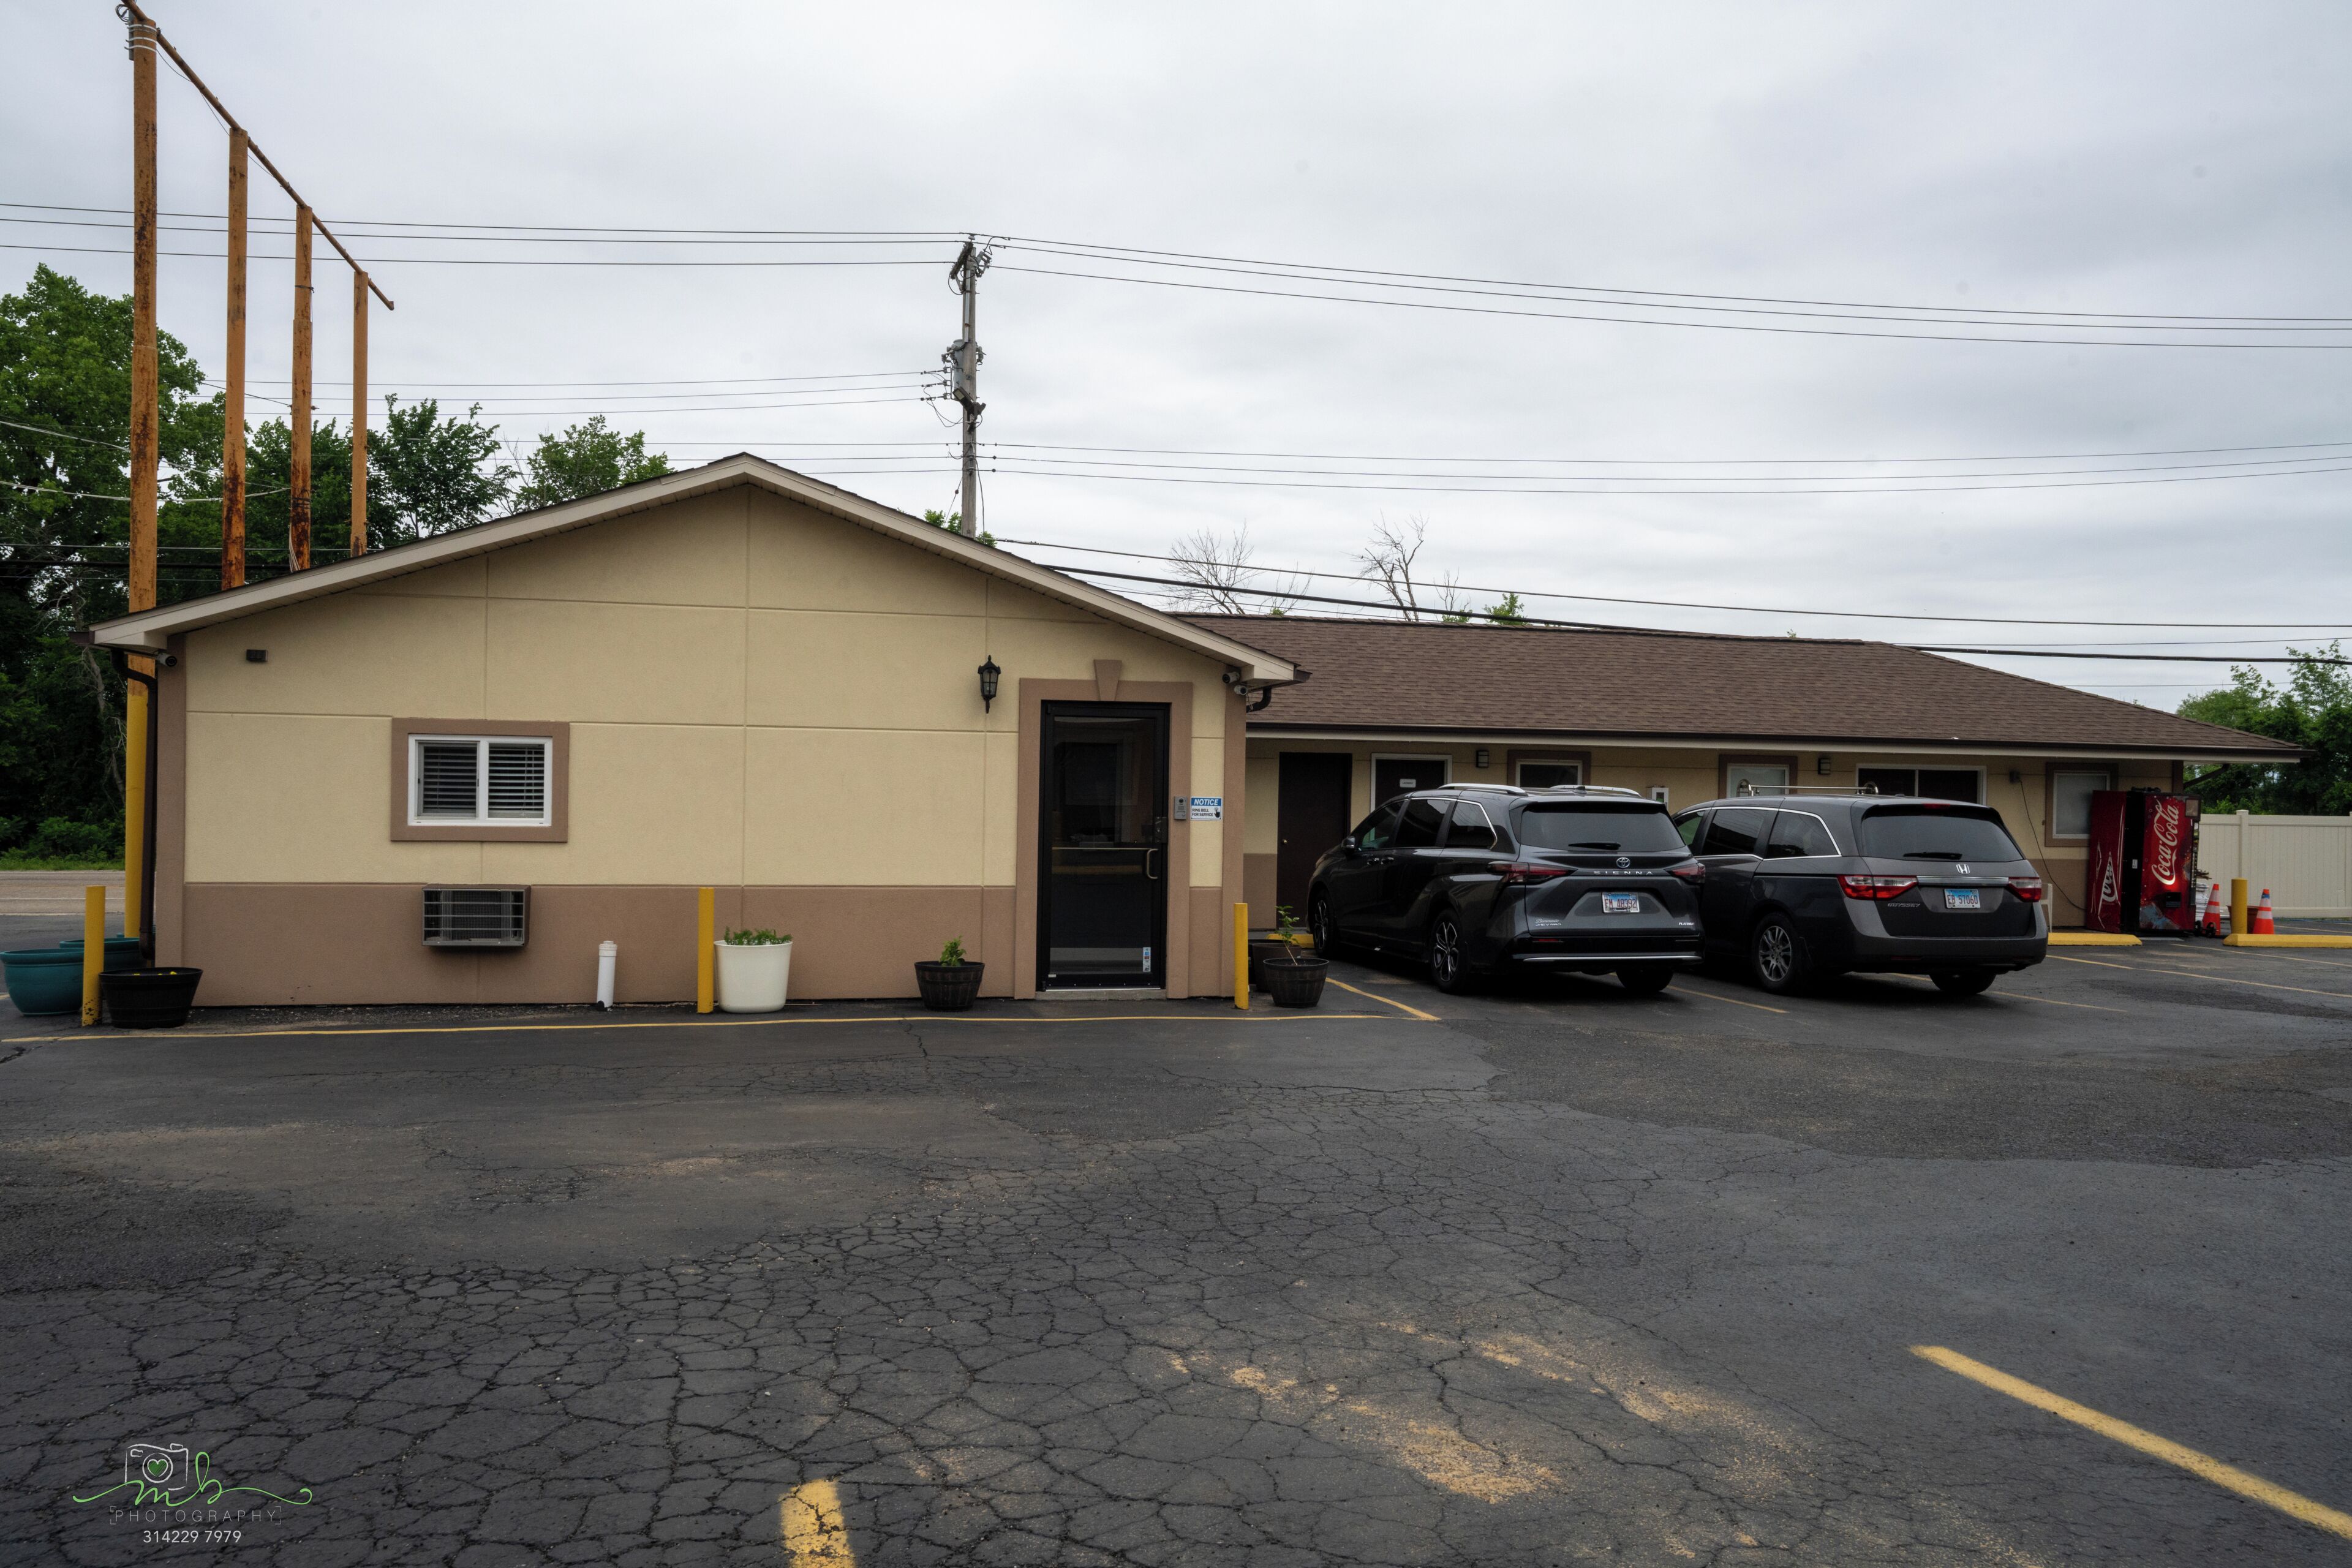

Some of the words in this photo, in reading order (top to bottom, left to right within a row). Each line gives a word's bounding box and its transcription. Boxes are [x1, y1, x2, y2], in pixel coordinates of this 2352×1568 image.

[2151, 799, 2179, 885] Coca-Cola
[1617, 898, 1637, 908] 48392
[1947, 895, 1956, 904] EB
[1958, 895, 1978, 904] 57060
